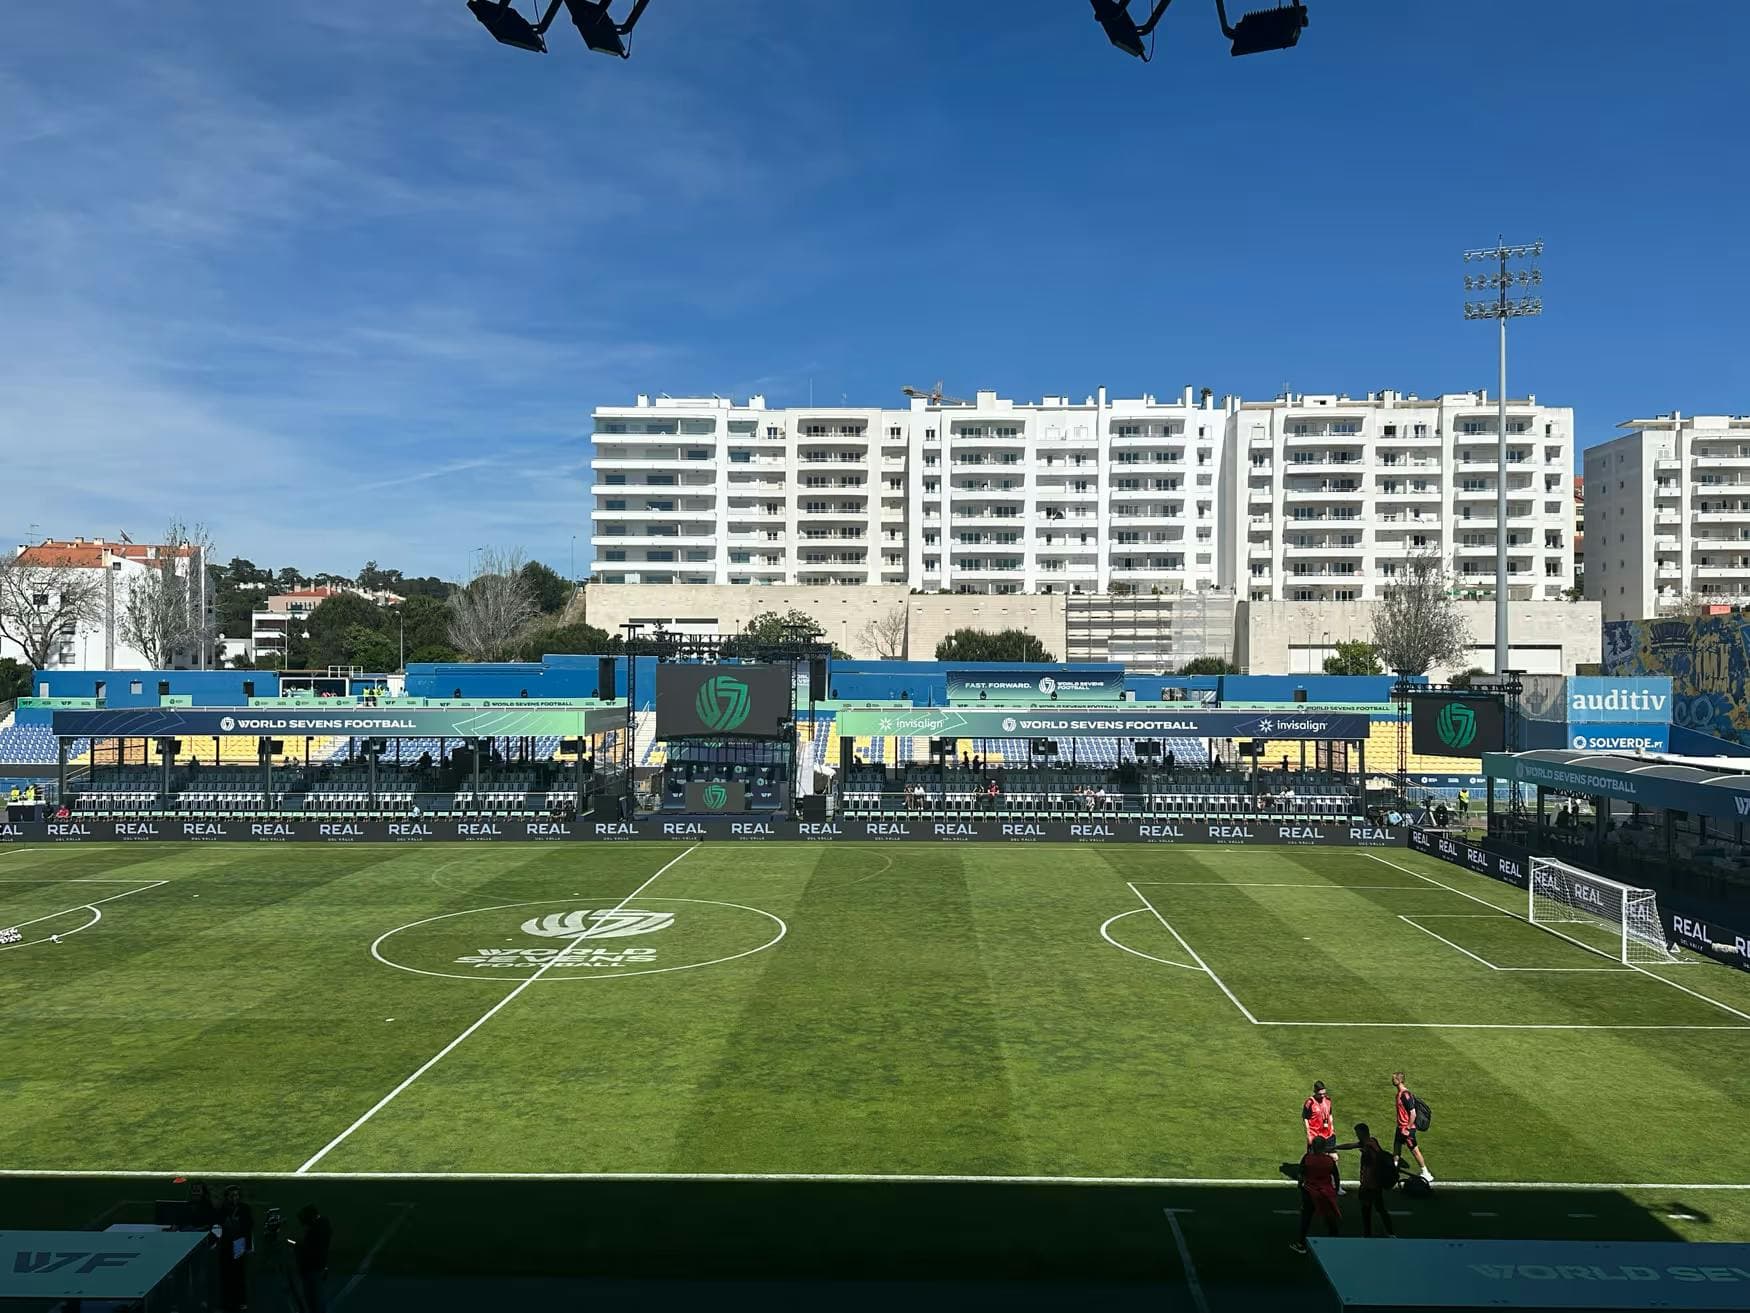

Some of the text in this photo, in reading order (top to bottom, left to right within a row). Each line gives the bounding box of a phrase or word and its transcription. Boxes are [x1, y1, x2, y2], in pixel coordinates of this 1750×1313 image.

[1572, 689, 1666, 711] auditiv
[238, 719, 416, 729] WORLD SEVENS FOOTBALL
[897, 718, 943, 731] invisalign
[1020, 720, 1198, 730] WORLD SEVENS FOOTBALL
[1277, 719, 1327, 733] invisalign
[1525, 766, 1636, 794] WORLD SEVENS FOOTBALL
[48, 823, 91, 835] REAL
[116, 823, 159, 835] REAL
[184, 823, 227, 835] REAL
[252, 823, 295, 835] REAL
[320, 823, 364, 835] REAL
[389, 823, 433, 835] REAL
[458, 823, 502, 835] REAL
[527, 823, 571, 835] REAL
[596, 823, 639, 835] REAL
[664, 823, 709, 835] REAL
[732, 823, 775, 835] REAL
[800, 823, 843, 835] REAL
[867, 823, 910, 835] REAL
[935, 823, 978, 835] REAL
[1003, 823, 1047, 835] REAL
[1071, 824, 1115, 835] REAL
[1140, 825, 1185, 837] REAL
[1209, 826, 1255, 838] REAL
[1279, 827, 1325, 839] REAL
[1350, 828, 1397, 840] REAL
[1412, 831, 1430, 847] REAL
[1439, 840, 1458, 856] REAL
[1467, 848, 1488, 867] REAL
[1499, 858, 1522, 878] REAL
[1534, 871, 1561, 891] REAL
[1574, 884, 1604, 906] REAL
[1673, 915, 1713, 944] REAL
[477, 948, 657, 956] WORLD
[452, 955, 657, 963] SEVENS
[1466, 1264, 1661, 1281] WORLD
